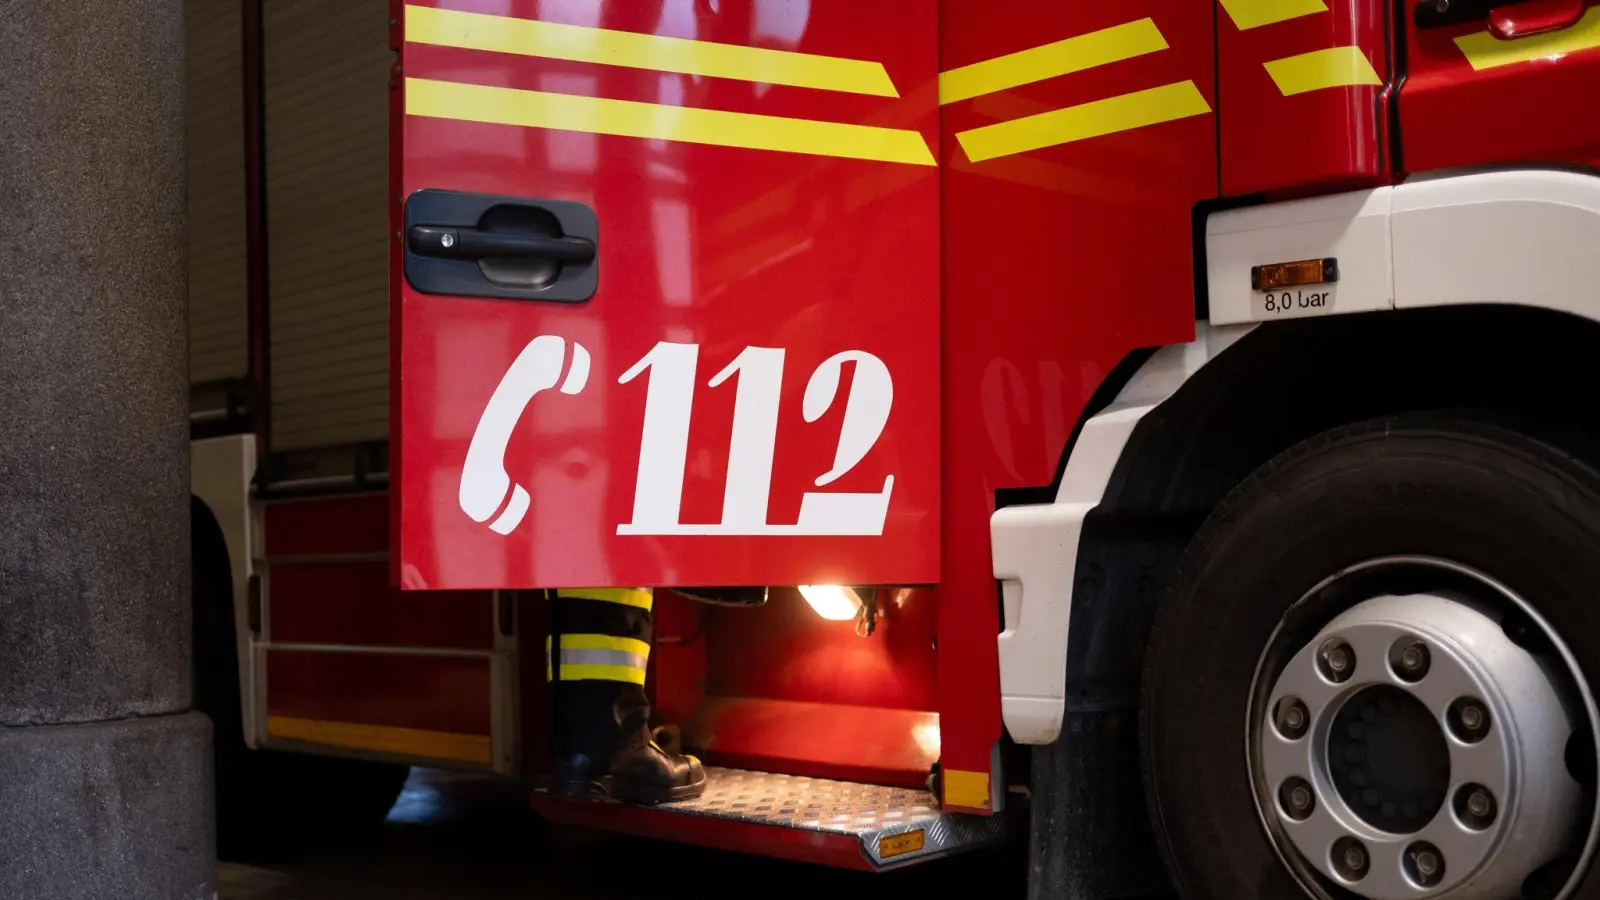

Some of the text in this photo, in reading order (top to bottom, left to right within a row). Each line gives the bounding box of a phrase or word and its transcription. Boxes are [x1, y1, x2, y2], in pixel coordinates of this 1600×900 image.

[1265, 291, 1329, 313] 8,0 bar
[616, 341, 894, 535] 112
